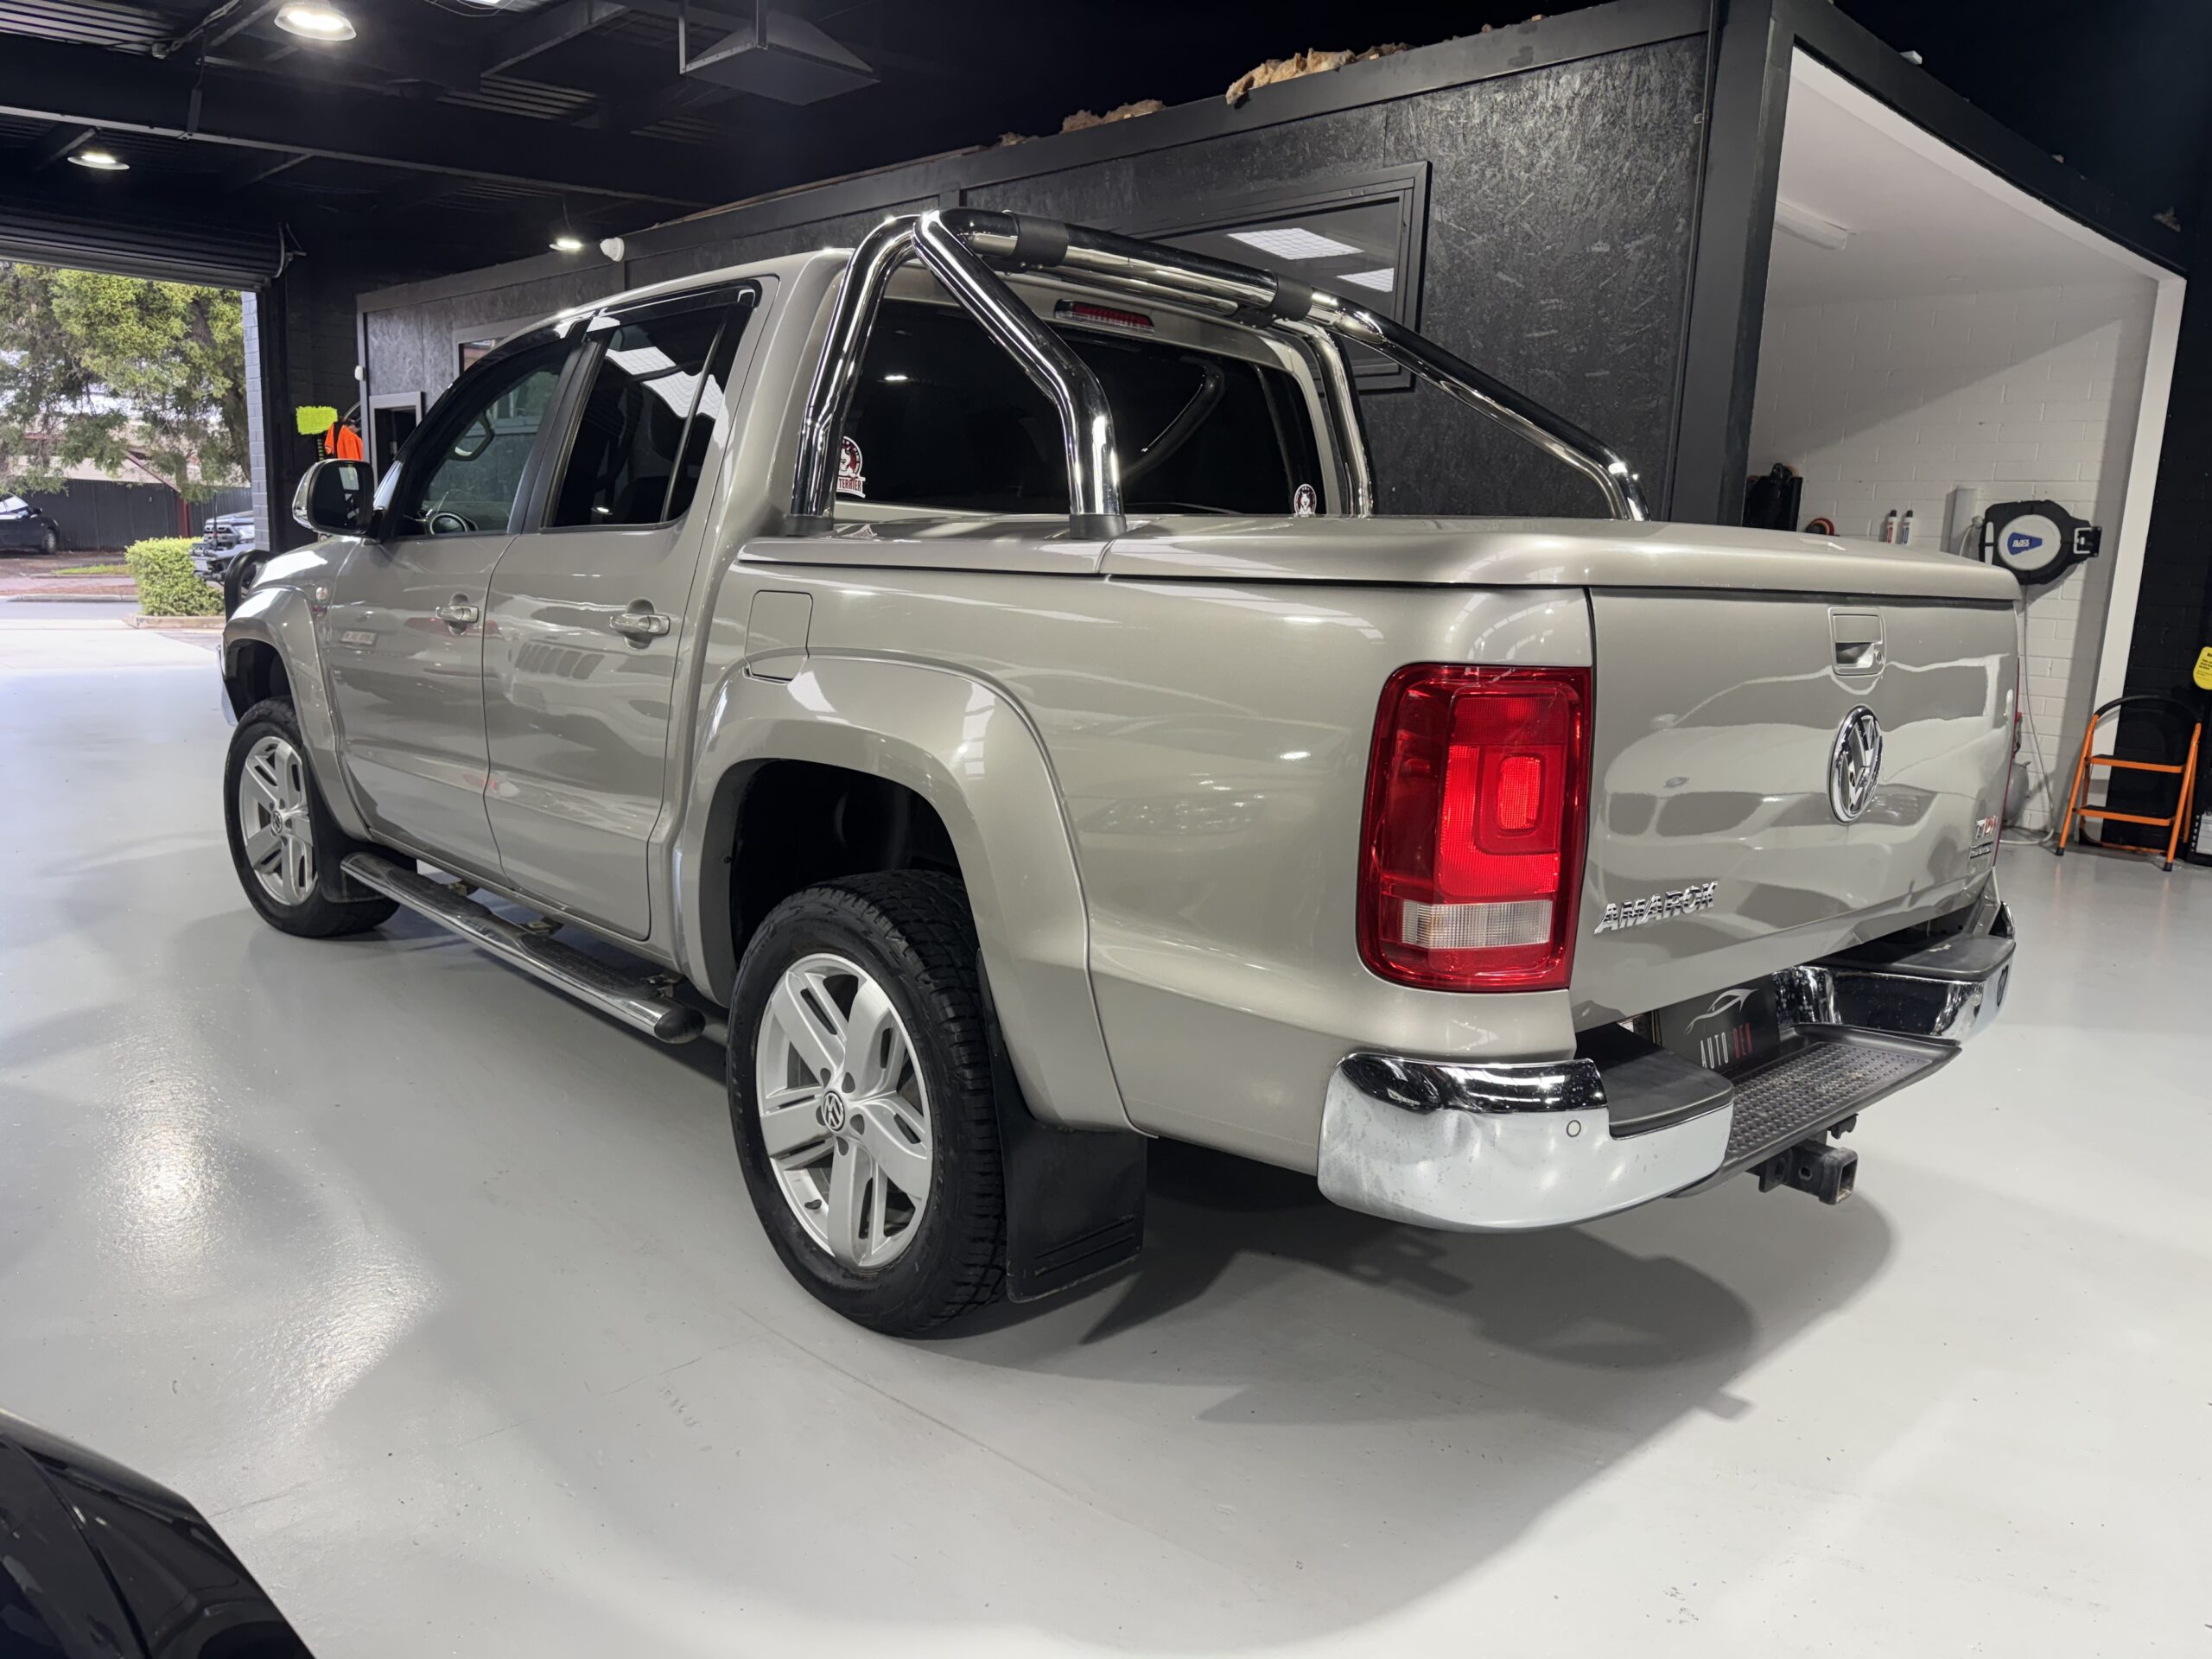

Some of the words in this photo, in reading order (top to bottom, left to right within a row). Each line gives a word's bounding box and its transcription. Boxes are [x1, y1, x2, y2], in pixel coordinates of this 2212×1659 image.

[838, 478, 861, 492] TERRIER
[1593, 880, 1719, 935] AMAROK
[1700, 1031, 1729, 1070] AUTO
